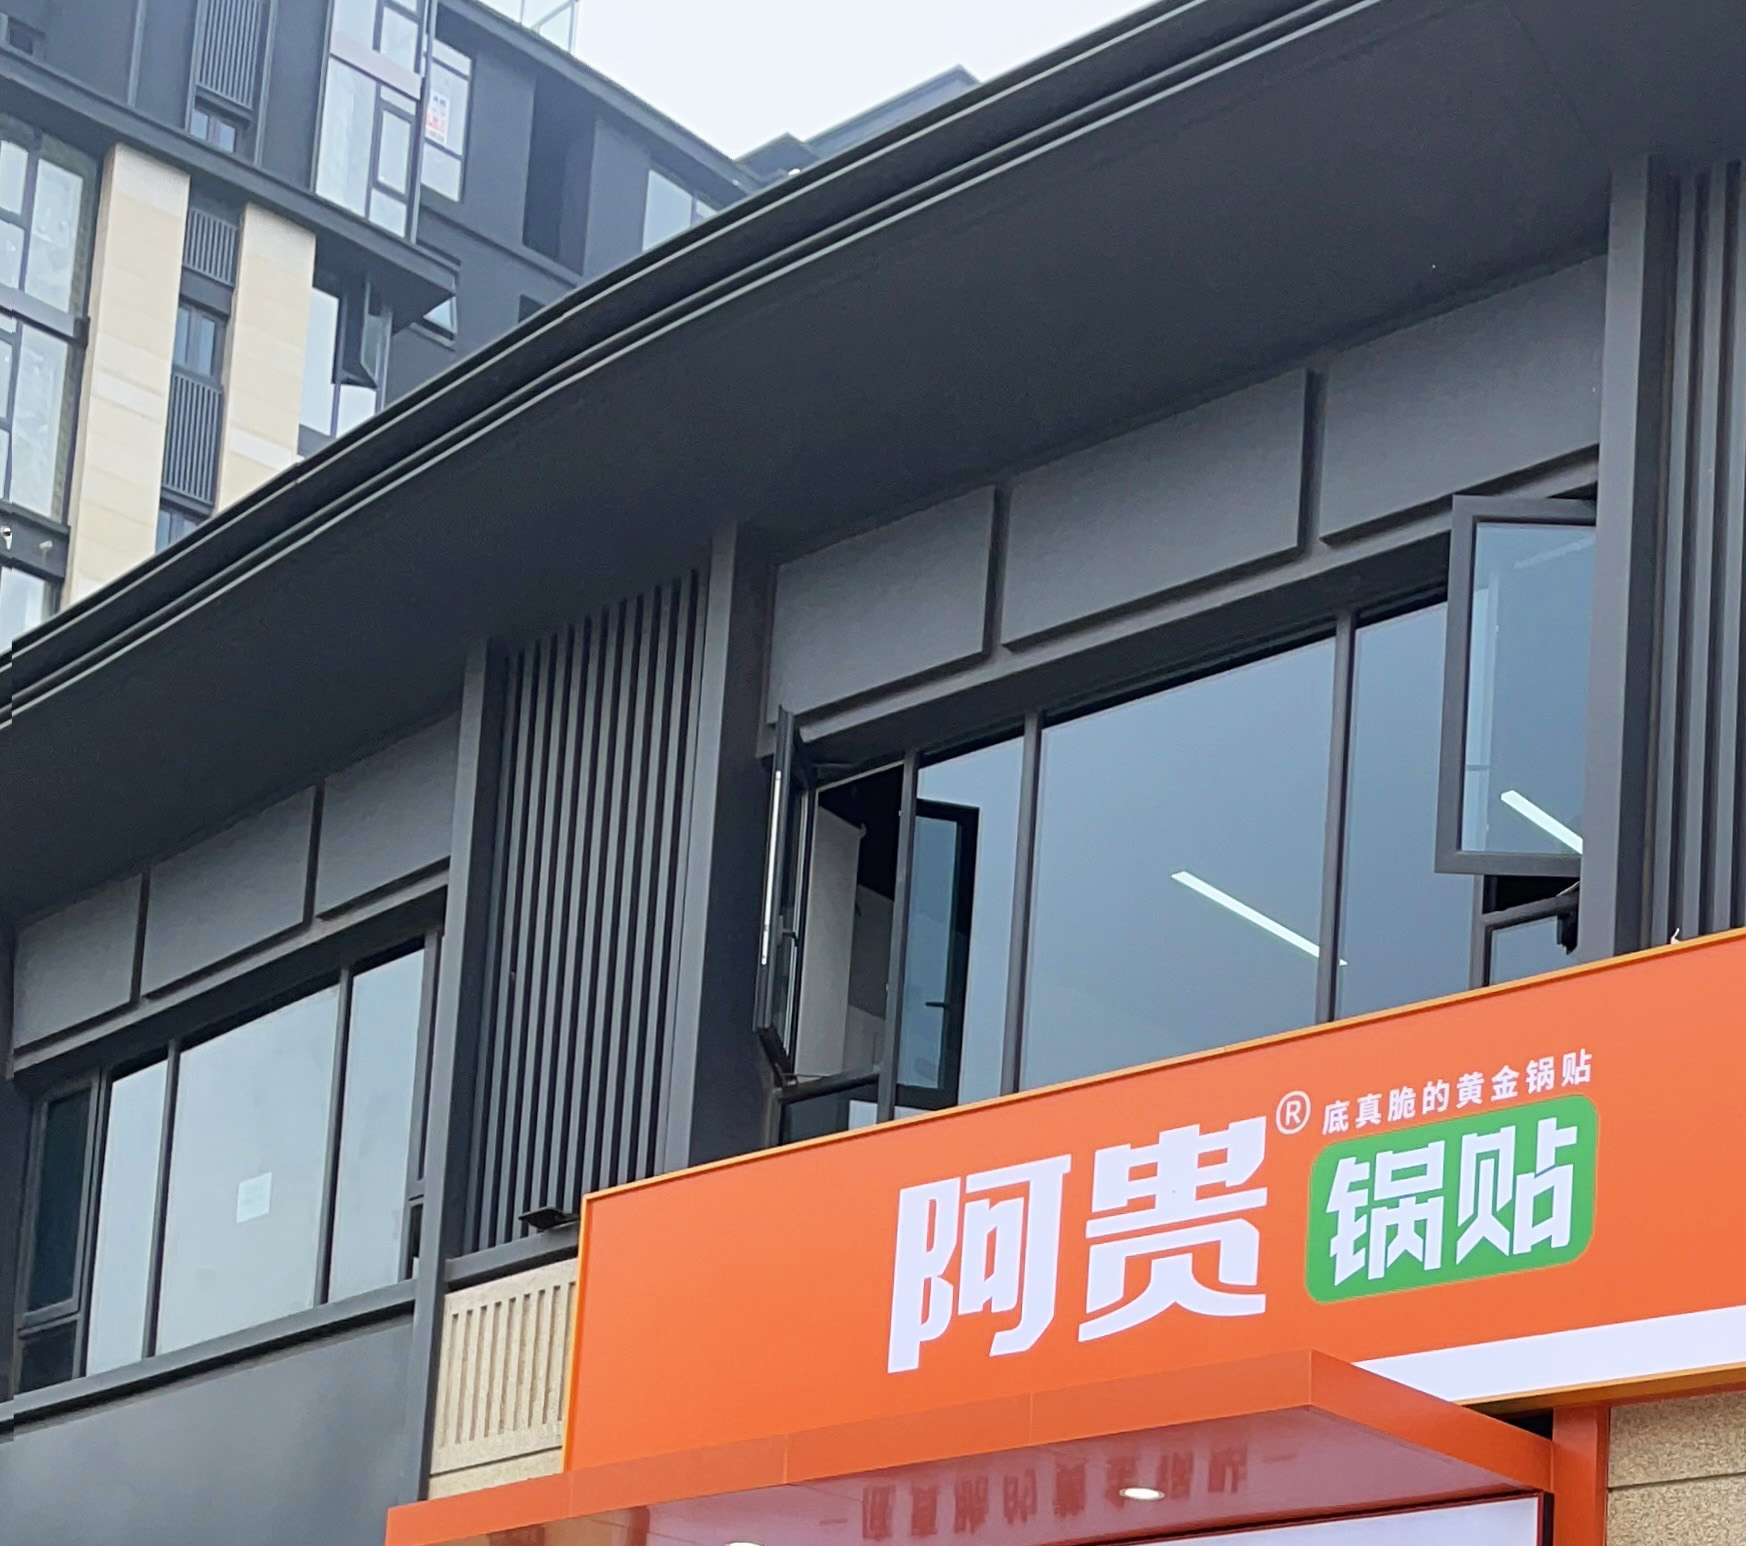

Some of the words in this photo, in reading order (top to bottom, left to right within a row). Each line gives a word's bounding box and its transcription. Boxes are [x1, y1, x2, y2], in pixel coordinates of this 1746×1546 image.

[1322, 1048, 1593, 1136] 底真脆的黄金锅贴
[888, 1116, 1268, 1374] 阿贵
[1325, 1117, 1579, 1286] 锅贴
